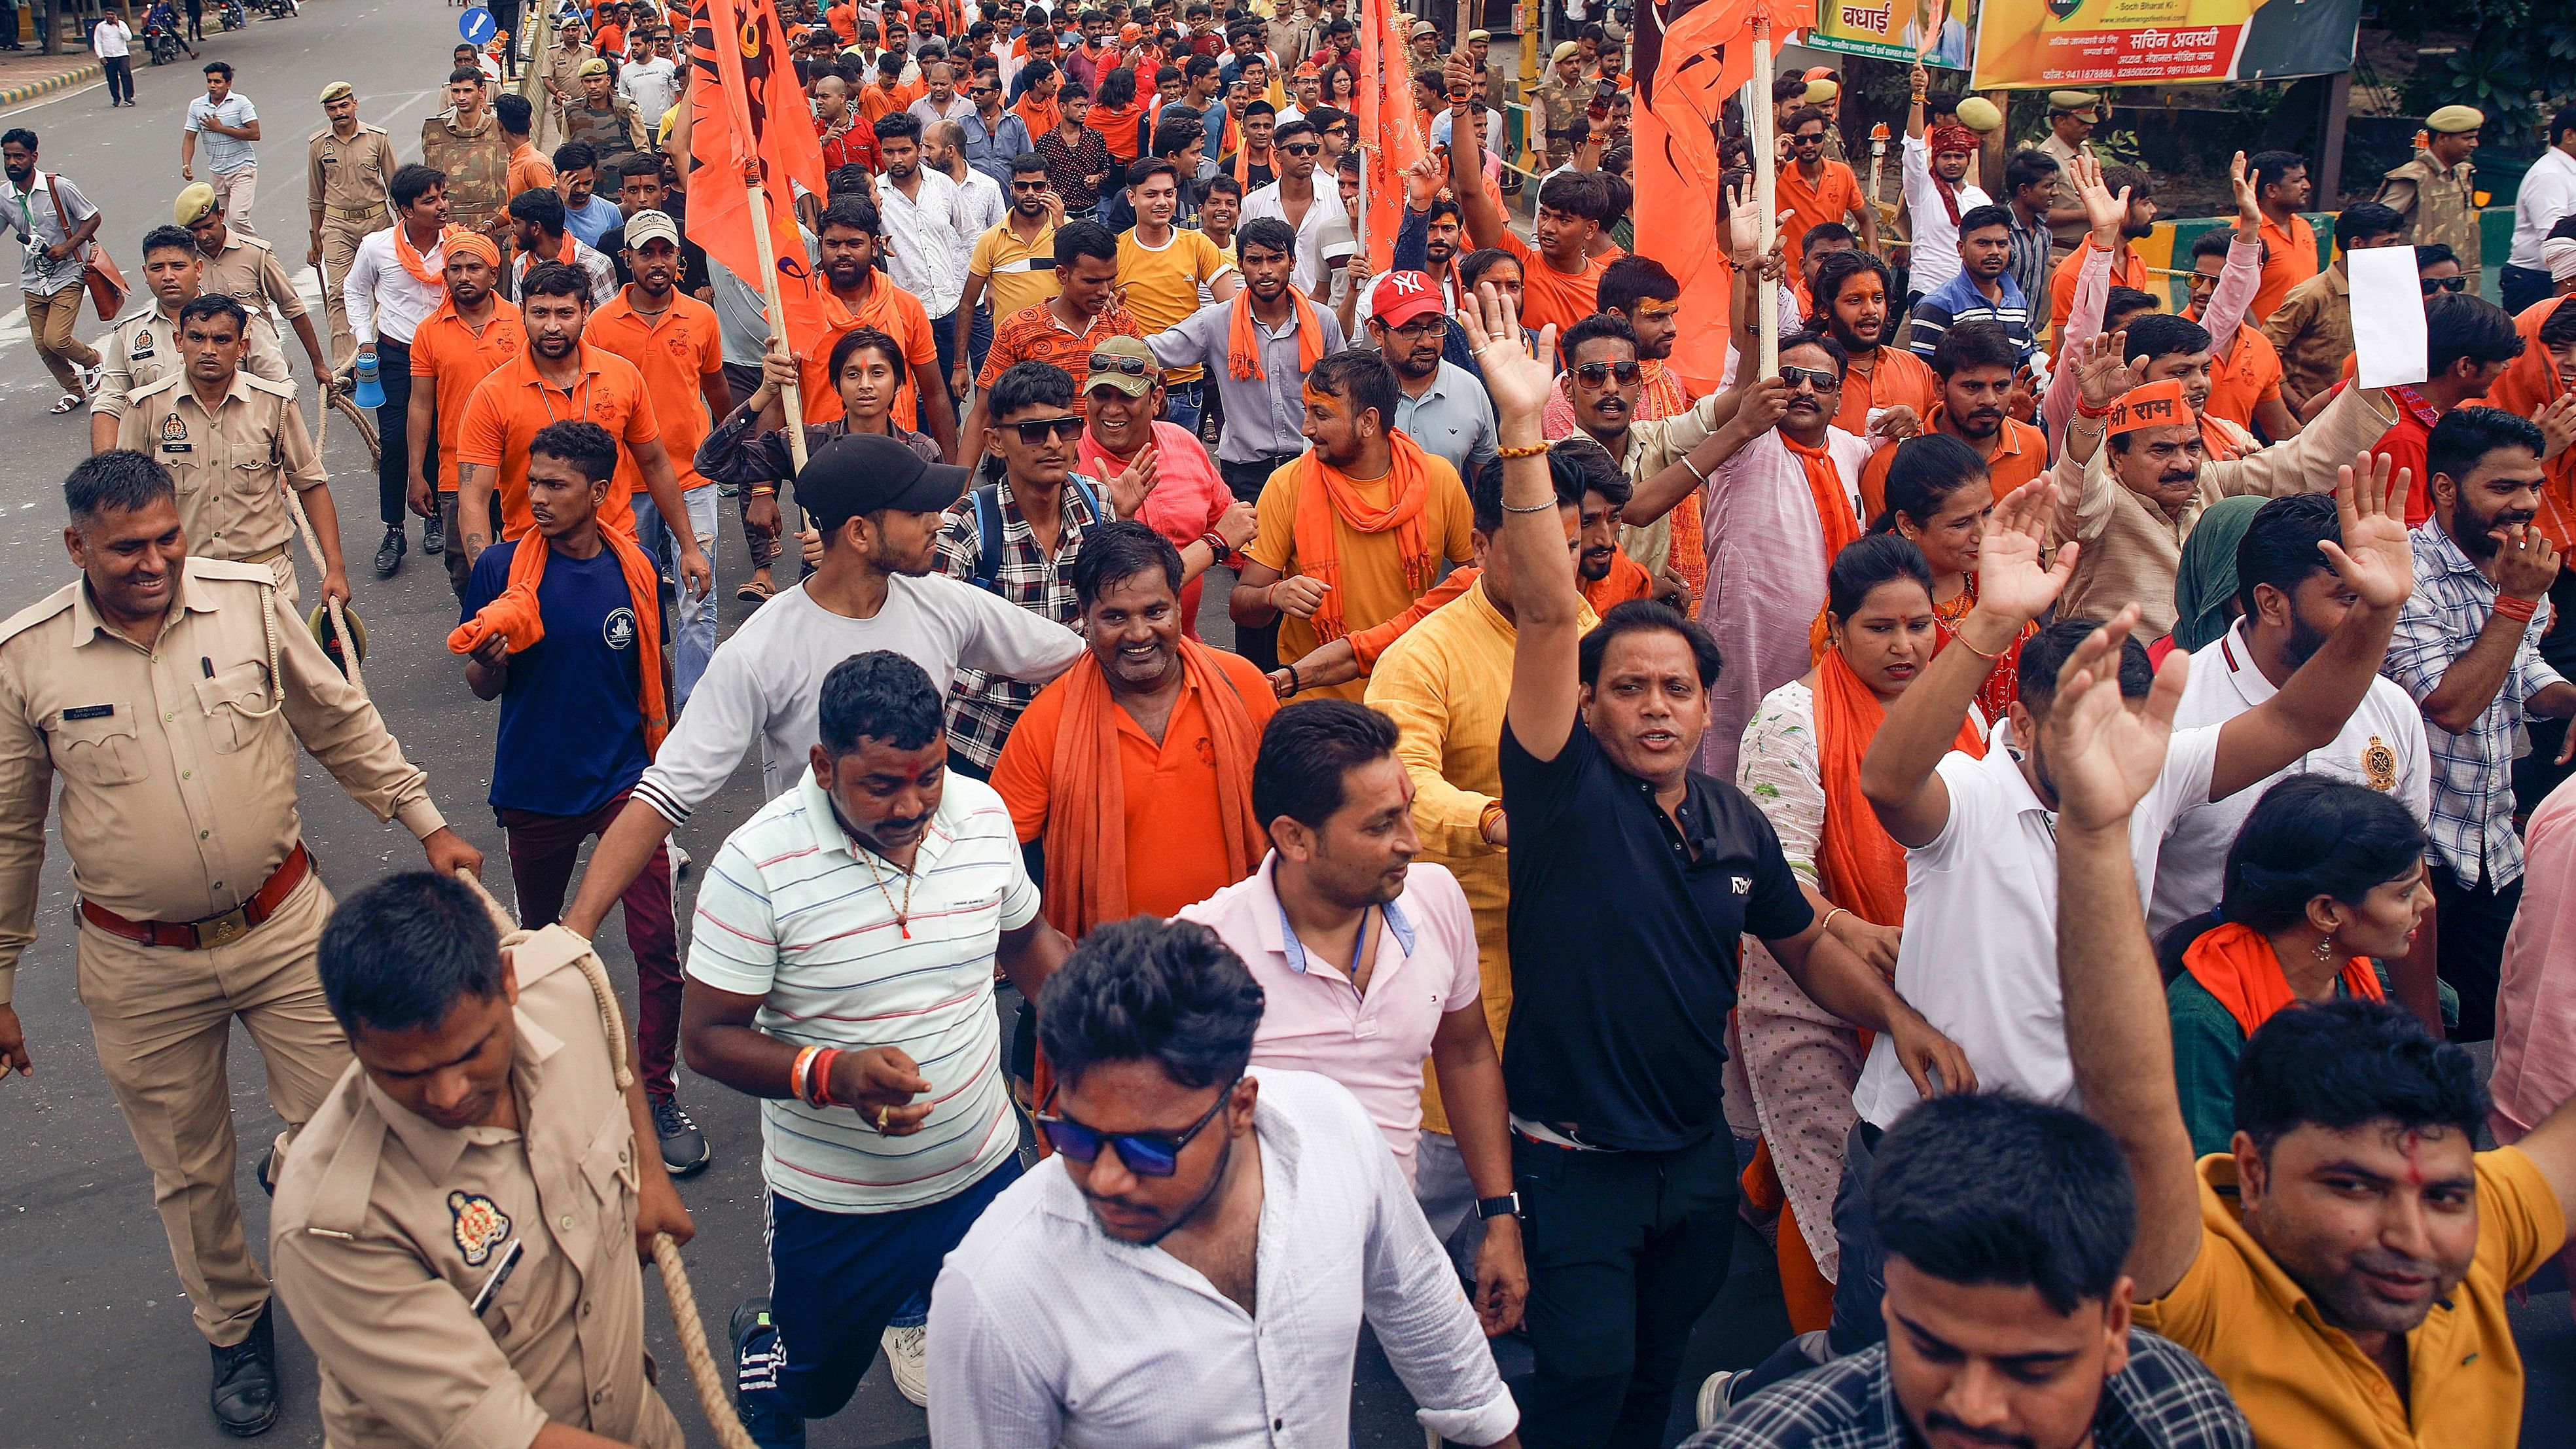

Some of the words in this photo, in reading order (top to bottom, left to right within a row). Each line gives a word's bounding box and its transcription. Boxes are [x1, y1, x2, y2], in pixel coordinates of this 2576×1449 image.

[2130, 29, 2171, 49] सचिन
[2172, 27, 2219, 48] अवस्थी
[2109, 402, 2127, 427] श्री
[2132, 399, 2172, 420] राम
